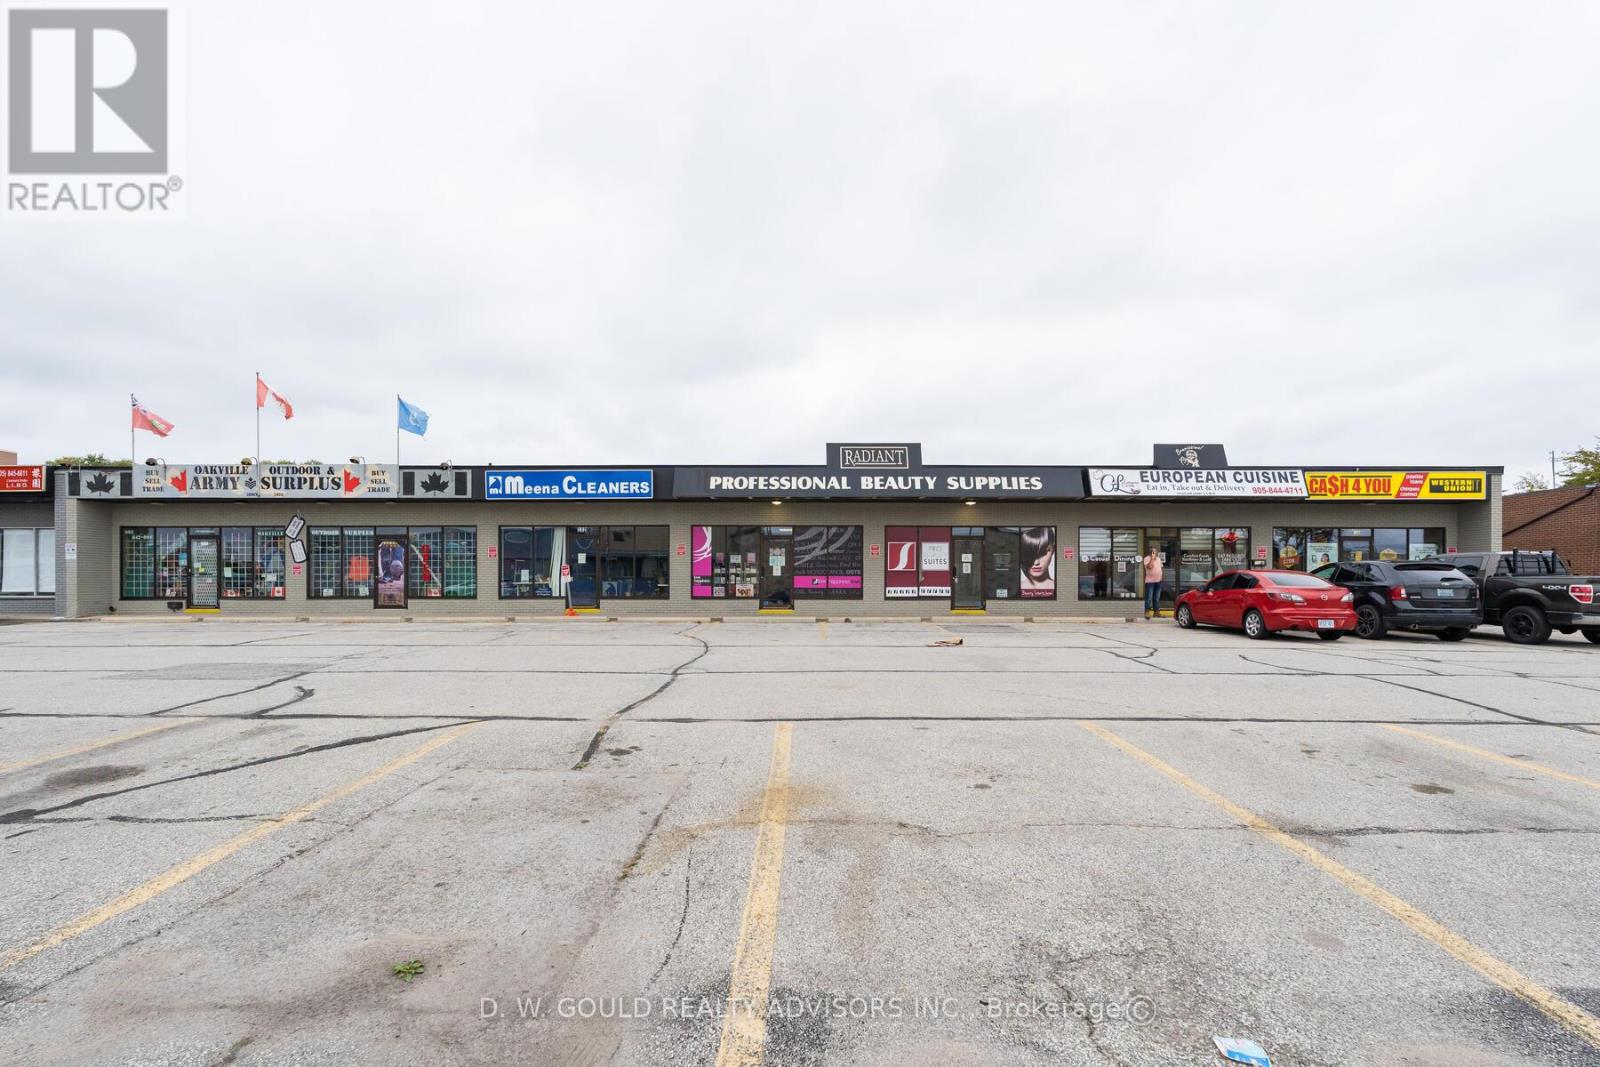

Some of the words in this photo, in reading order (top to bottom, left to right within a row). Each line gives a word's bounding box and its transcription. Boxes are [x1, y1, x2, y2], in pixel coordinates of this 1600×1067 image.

[844, 449, 904, 466] RADIANT
[194, 465, 249, 475] OAKVILLE
[269, 466, 321, 475] OUTDOOR
[326, 466, 335, 475] &
[1139, 470, 1227, 484] EUROPEAN
[1232, 471, 1300, 484] CUISINE
[189, 476, 240, 490] ARMY
[260, 476, 342, 491] SURPLUS
[504, 475, 560, 495] Meena
[562, 475, 650, 494] CLEANERS
[709, 475, 851, 490] PROFESSIONAL
[860, 476, 937, 490] BEAUTY
[946, 476, 1043, 490] SUPPLIES
[1160, 484, 1170, 492] in,
[1309, 474, 1349, 496] CA$H
[1352, 478, 1361, 493] 4
[1364, 478, 1391, 493] YOU
[1252, 486, 1303, 495] 905-844-4711
[1114, 555, 1135, 564] Dining
